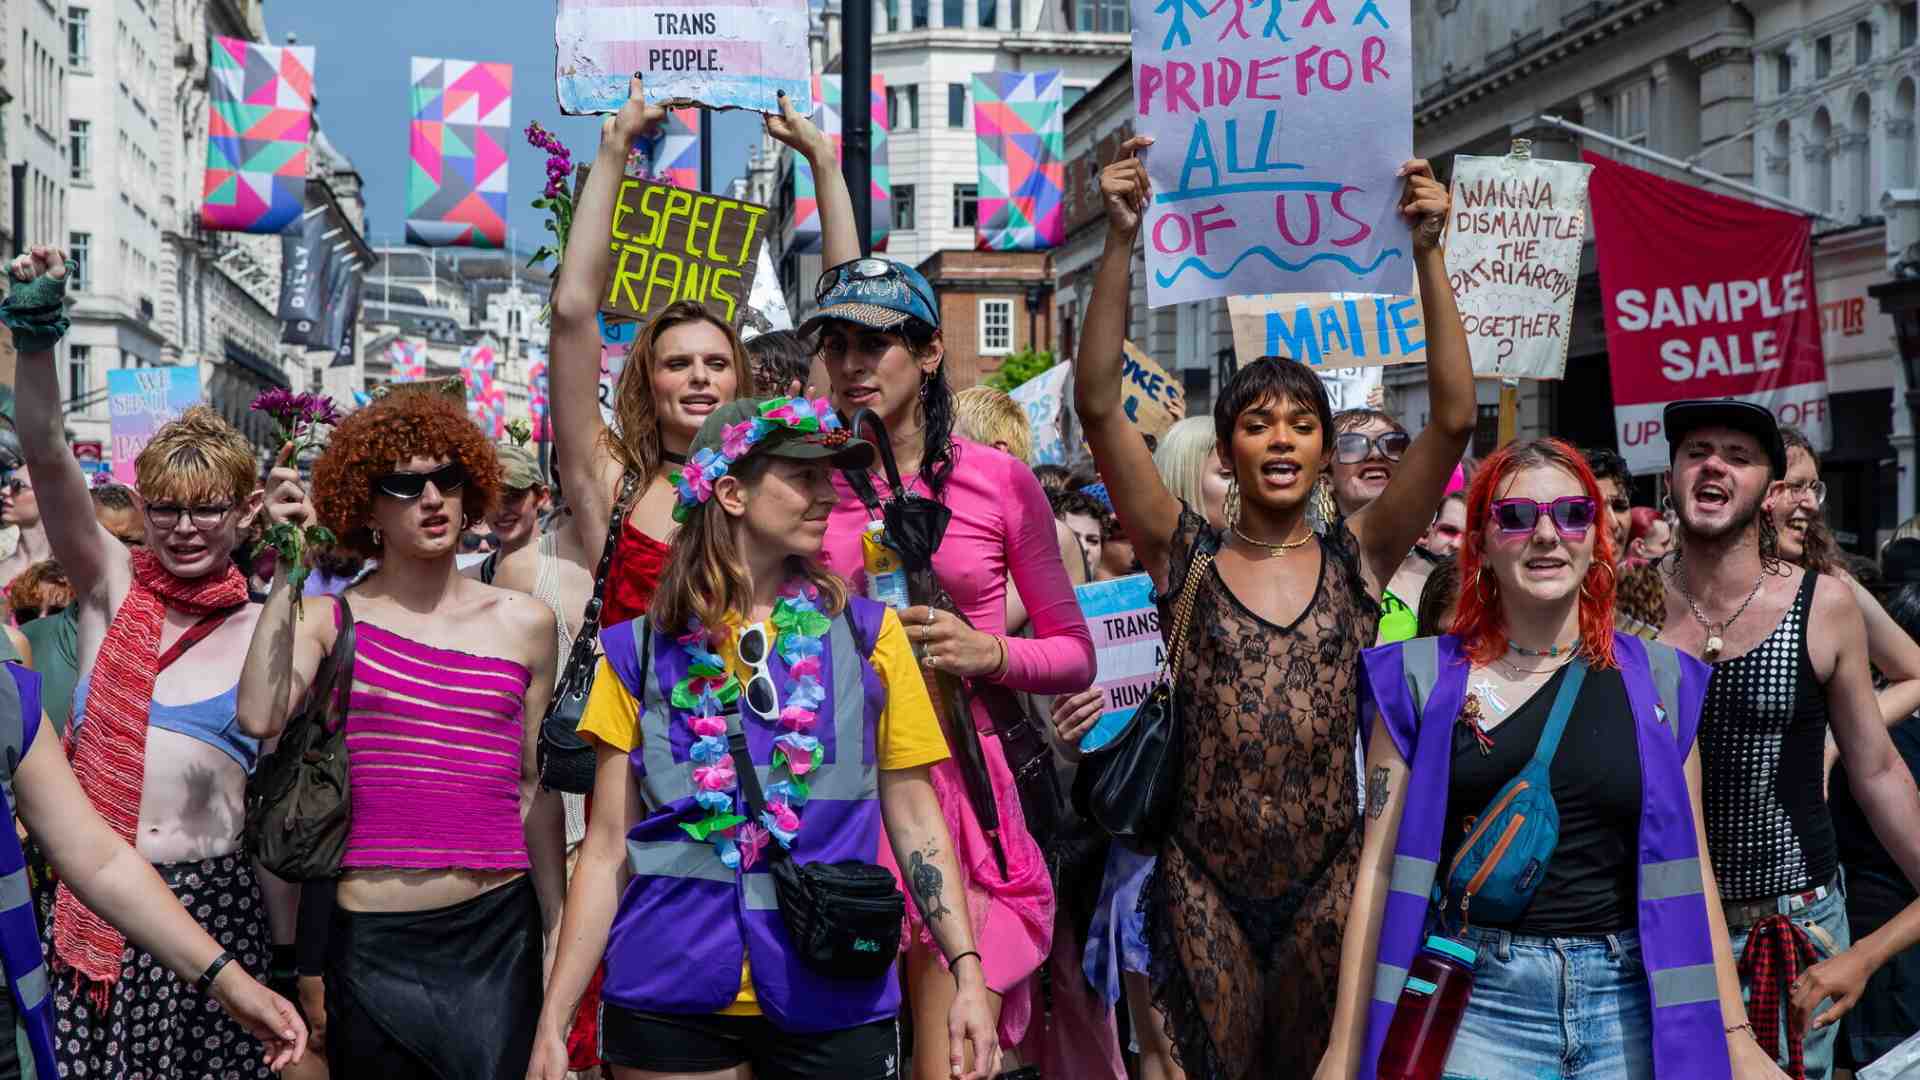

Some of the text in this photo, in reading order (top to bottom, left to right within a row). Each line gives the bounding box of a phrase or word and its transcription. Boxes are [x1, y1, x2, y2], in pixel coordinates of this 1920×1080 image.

[654, 12, 716, 35] TRANS
[649, 48, 724, 72] PEOPLE.
[1138, 36, 1391, 116] PRIDE FOR
[1179, 110, 1305, 196] ALL
[1459, 176, 1554, 210] WANNA
[1152, 186, 1372, 256] OF US
[1456, 211, 1579, 240] DISMANTLE
[1497, 239, 1541, 265] THE
[609, 242, 742, 322] RANS
[1450, 257, 1573, 304] PATRIARCHY
[1615, 270, 1807, 331] SAMPLE
[1494, 338, 1514, 373] ?
[1659, 330, 1781, 381] SALE
[1623, 420, 1661, 447] UP
[1103, 611, 1160, 640] TRANS
